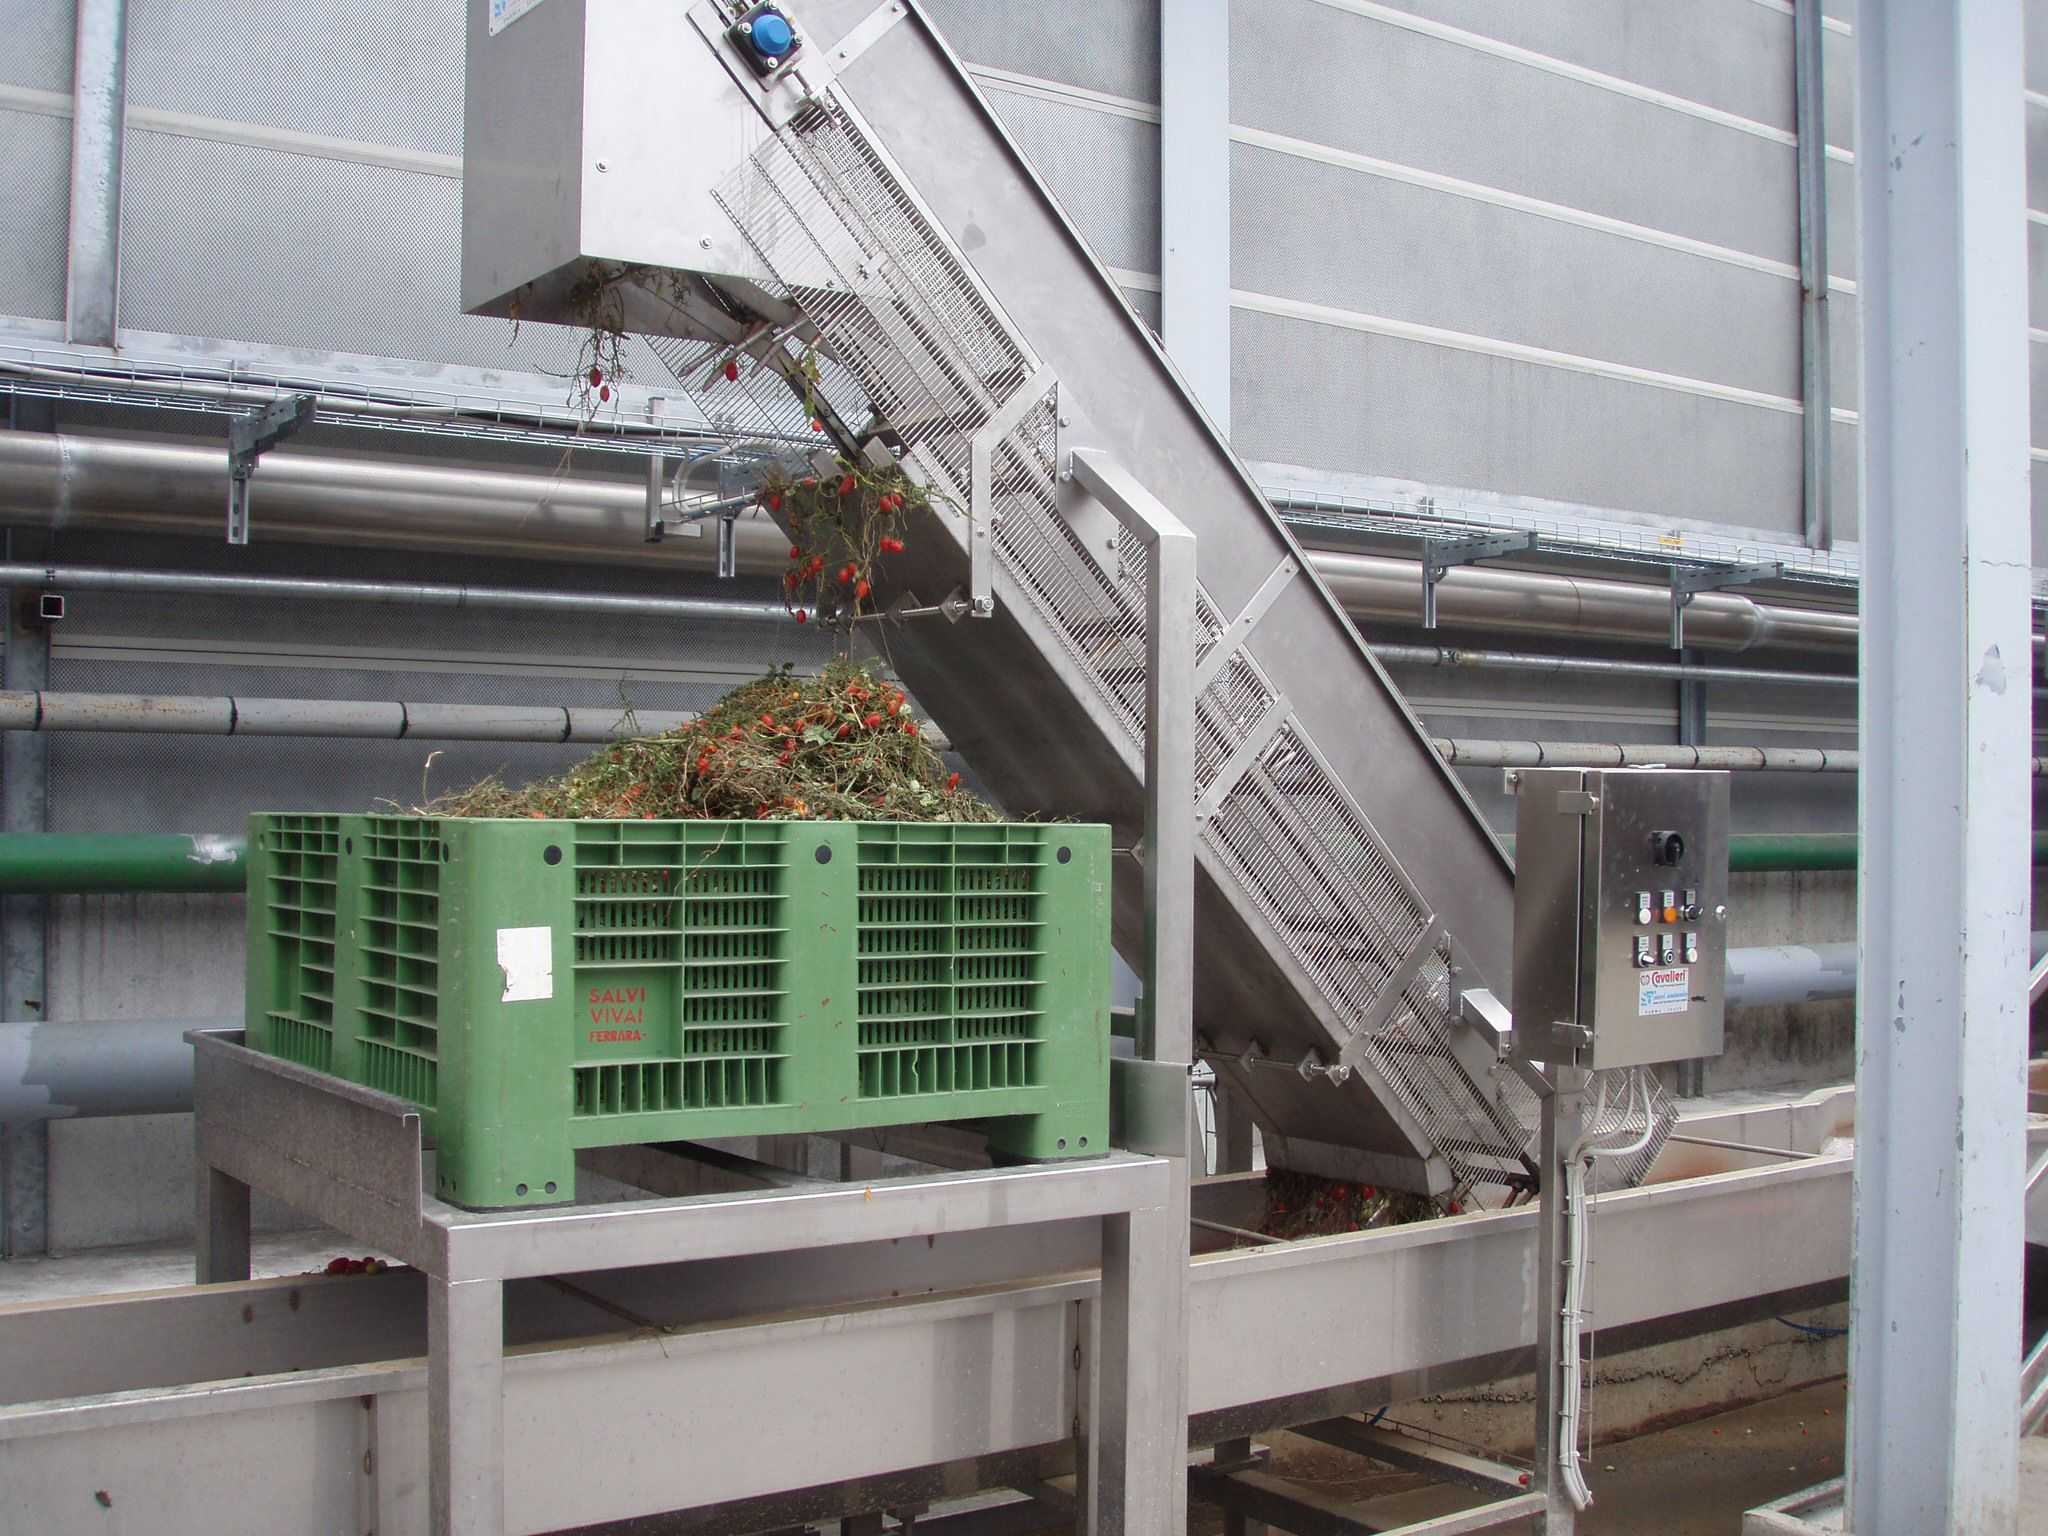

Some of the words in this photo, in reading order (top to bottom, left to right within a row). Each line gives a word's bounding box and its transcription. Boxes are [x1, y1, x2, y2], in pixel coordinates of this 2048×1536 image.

[1652, 970, 1686, 987] Cavalieri
[589, 987, 645, 1003] SALVI
[591, 1007, 643, 1024] VIVAI
